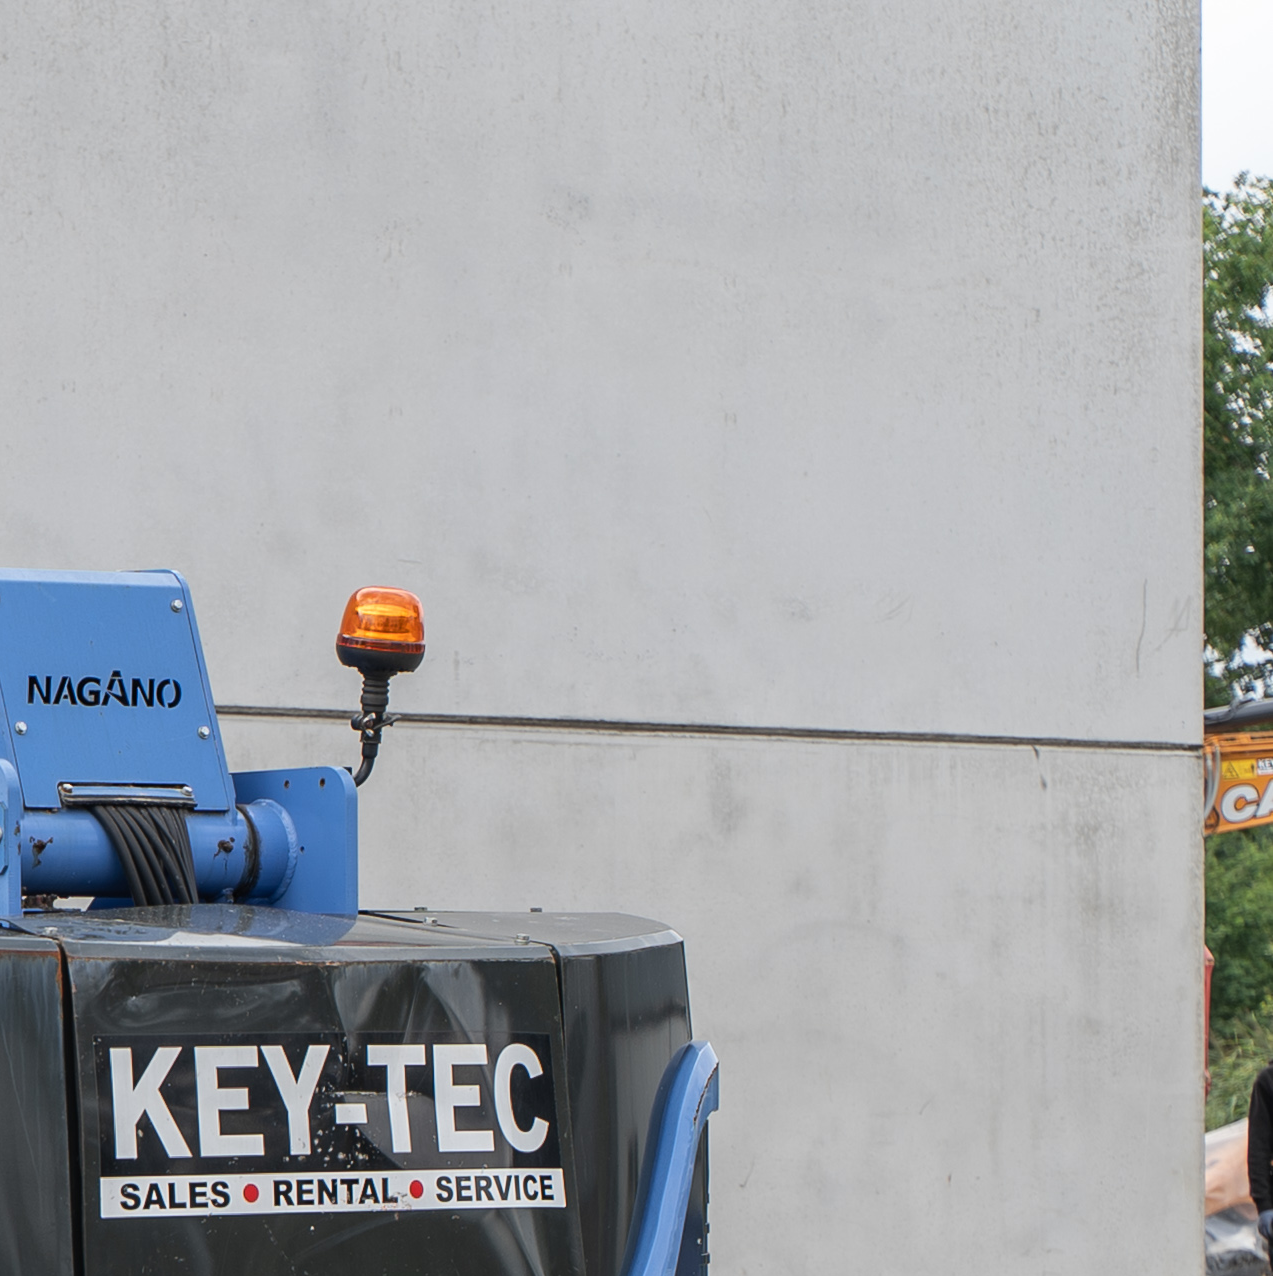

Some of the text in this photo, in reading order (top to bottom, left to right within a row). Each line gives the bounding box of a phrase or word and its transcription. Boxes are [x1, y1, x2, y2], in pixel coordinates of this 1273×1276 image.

[27, 669, 182, 709] NAGANO
[109, 1042, 550, 1160] KEY-TEC
[119, 1174, 555, 1211] SALES RENTAL SERVICE
